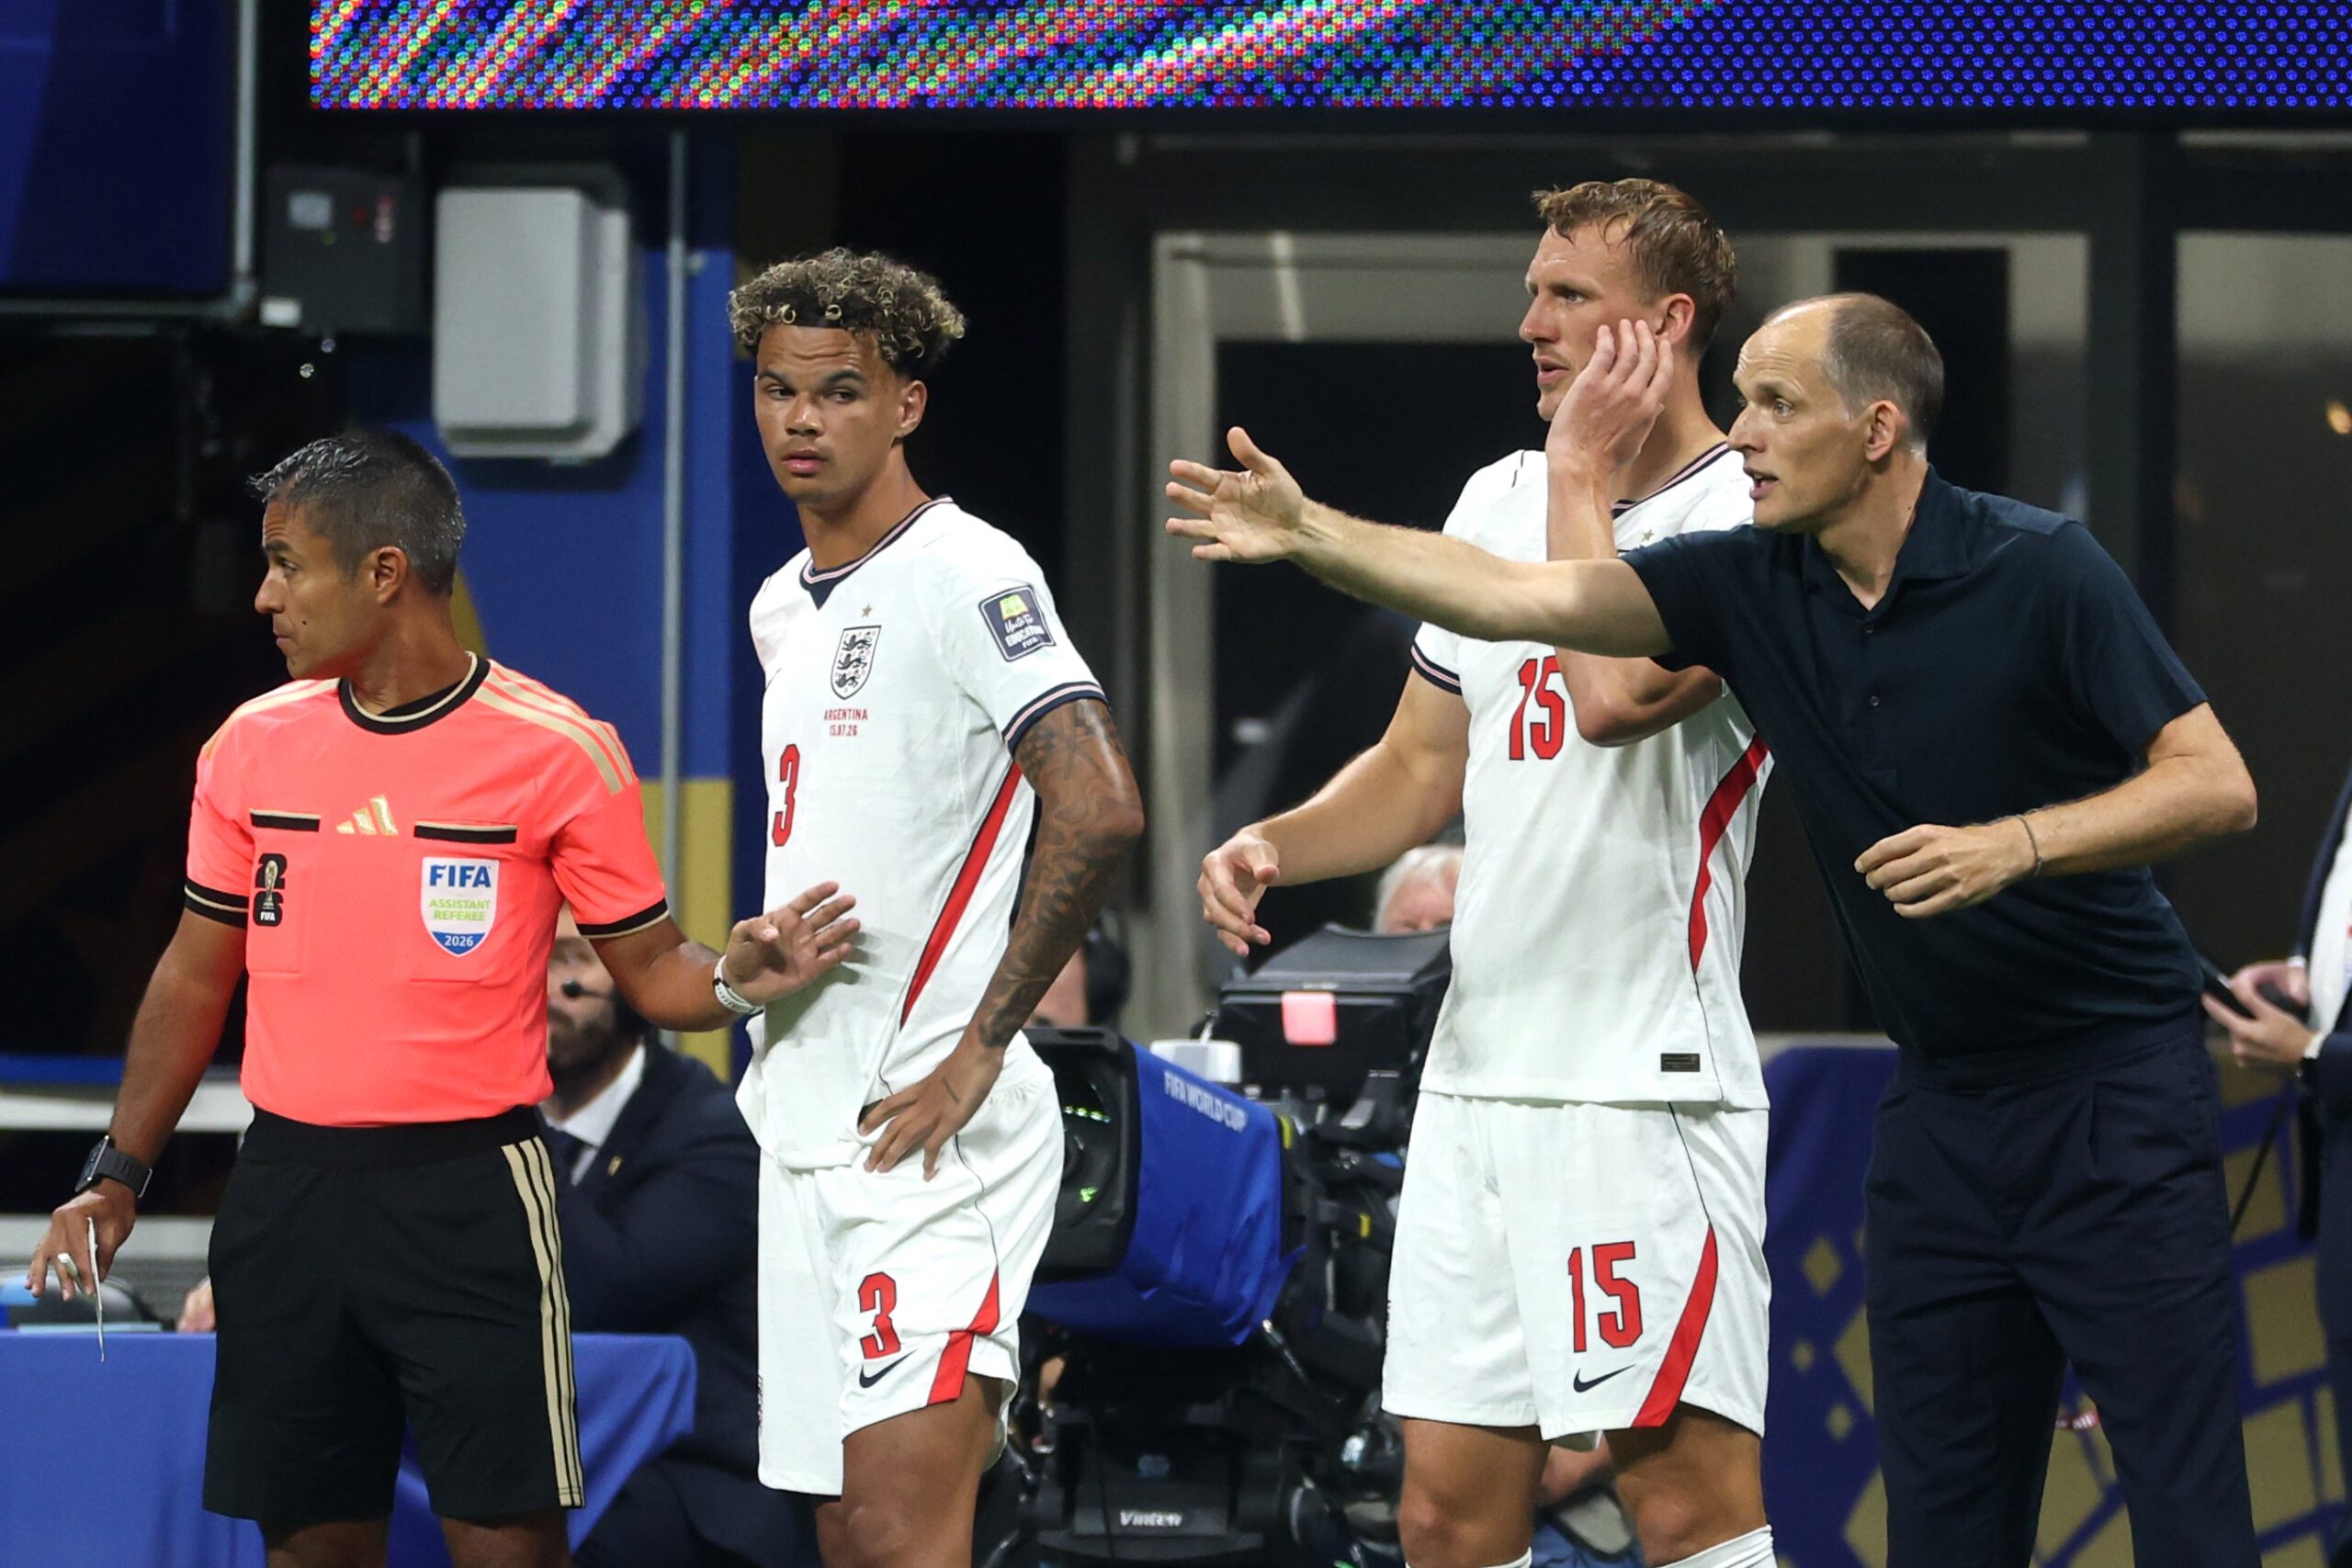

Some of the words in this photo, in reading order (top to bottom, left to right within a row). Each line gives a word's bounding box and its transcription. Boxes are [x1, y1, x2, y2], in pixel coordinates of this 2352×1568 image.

[823, 708, 867, 721] ARGENTINA
[1509, 655, 1566, 761] 15
[830, 724, 857, 736] 15.07.26
[772, 743, 800, 847] 3
[429, 864, 492, 887] FIFA
[429, 898, 491, 909] ASSISTANT
[260, 911, 276, 921] FIFA
[434, 910, 485, 921] REFEREE
[444, 935, 474, 947] 2026
[1163, 1070, 1186, 1104] FIFA
[1186, 1084, 1223, 1122] WORLD
[1223, 1103, 1248, 1133] CUP
[1567, 1240, 1644, 1353] 15
[858, 1271, 901, 1359] 3
[1120, 1510, 1182, 1527] Vinten
